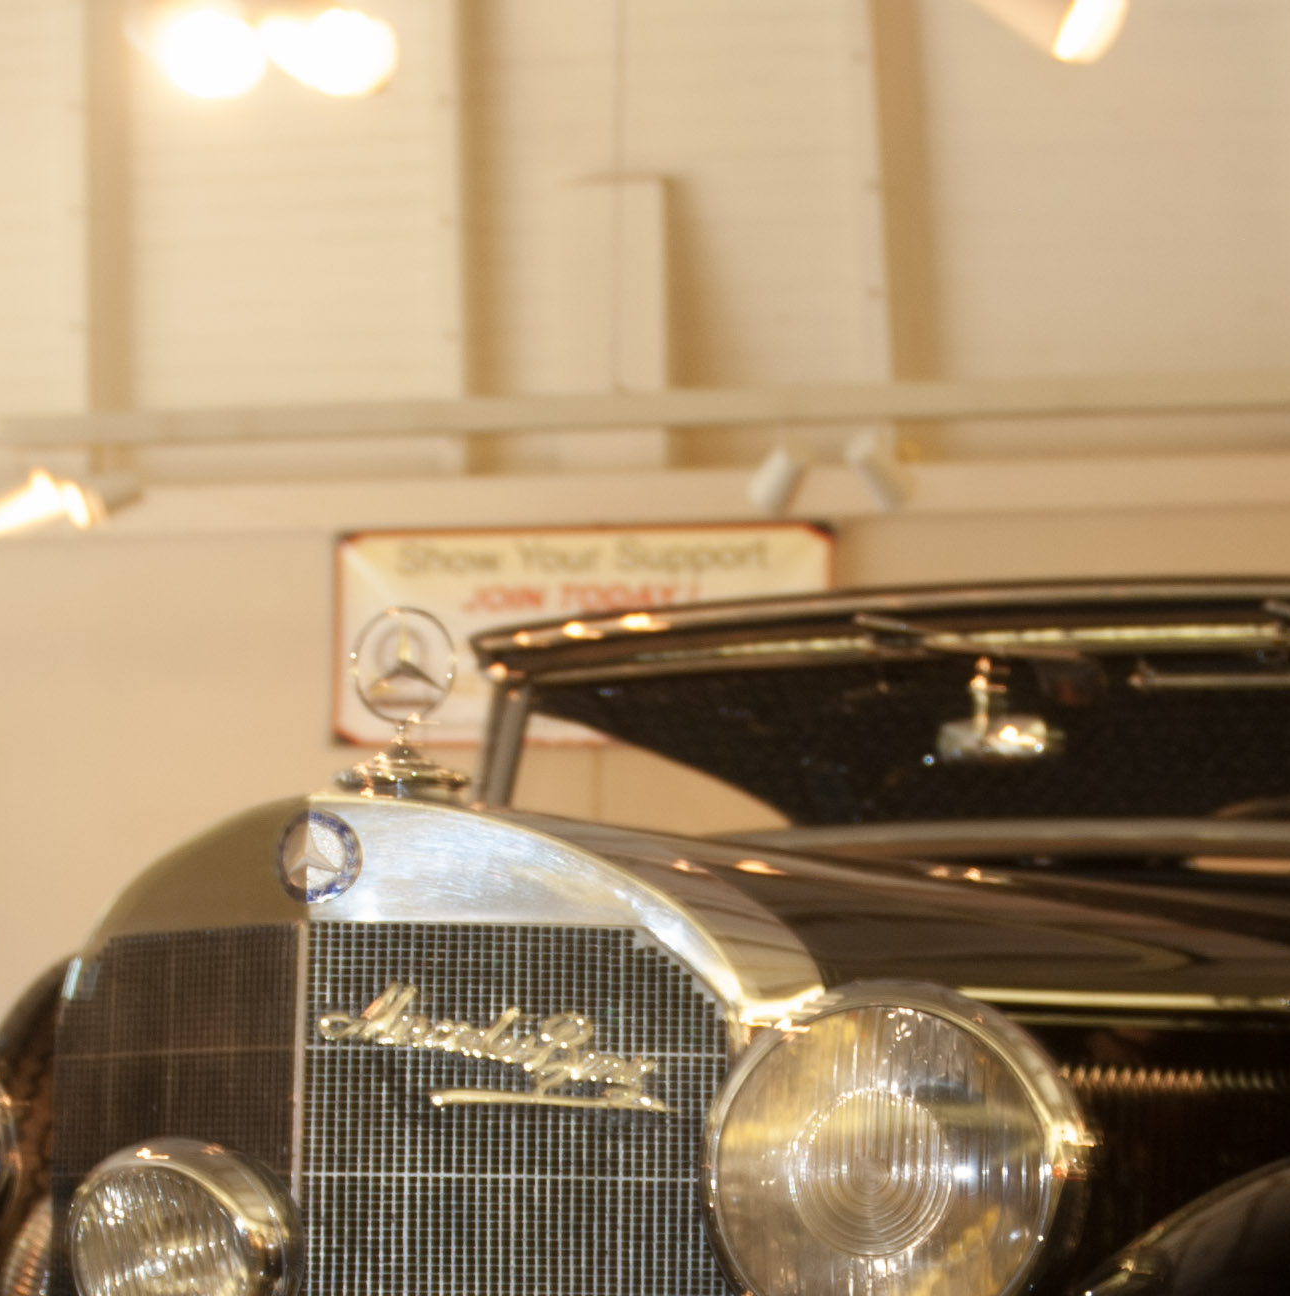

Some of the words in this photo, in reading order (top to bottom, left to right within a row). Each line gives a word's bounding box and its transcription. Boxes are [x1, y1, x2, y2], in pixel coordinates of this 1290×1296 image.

[395, 539, 503, 577] Show
[514, 538, 600, 573] Your
[613, 535, 769, 580] Support
[461, 584, 547, 614] JOIN
